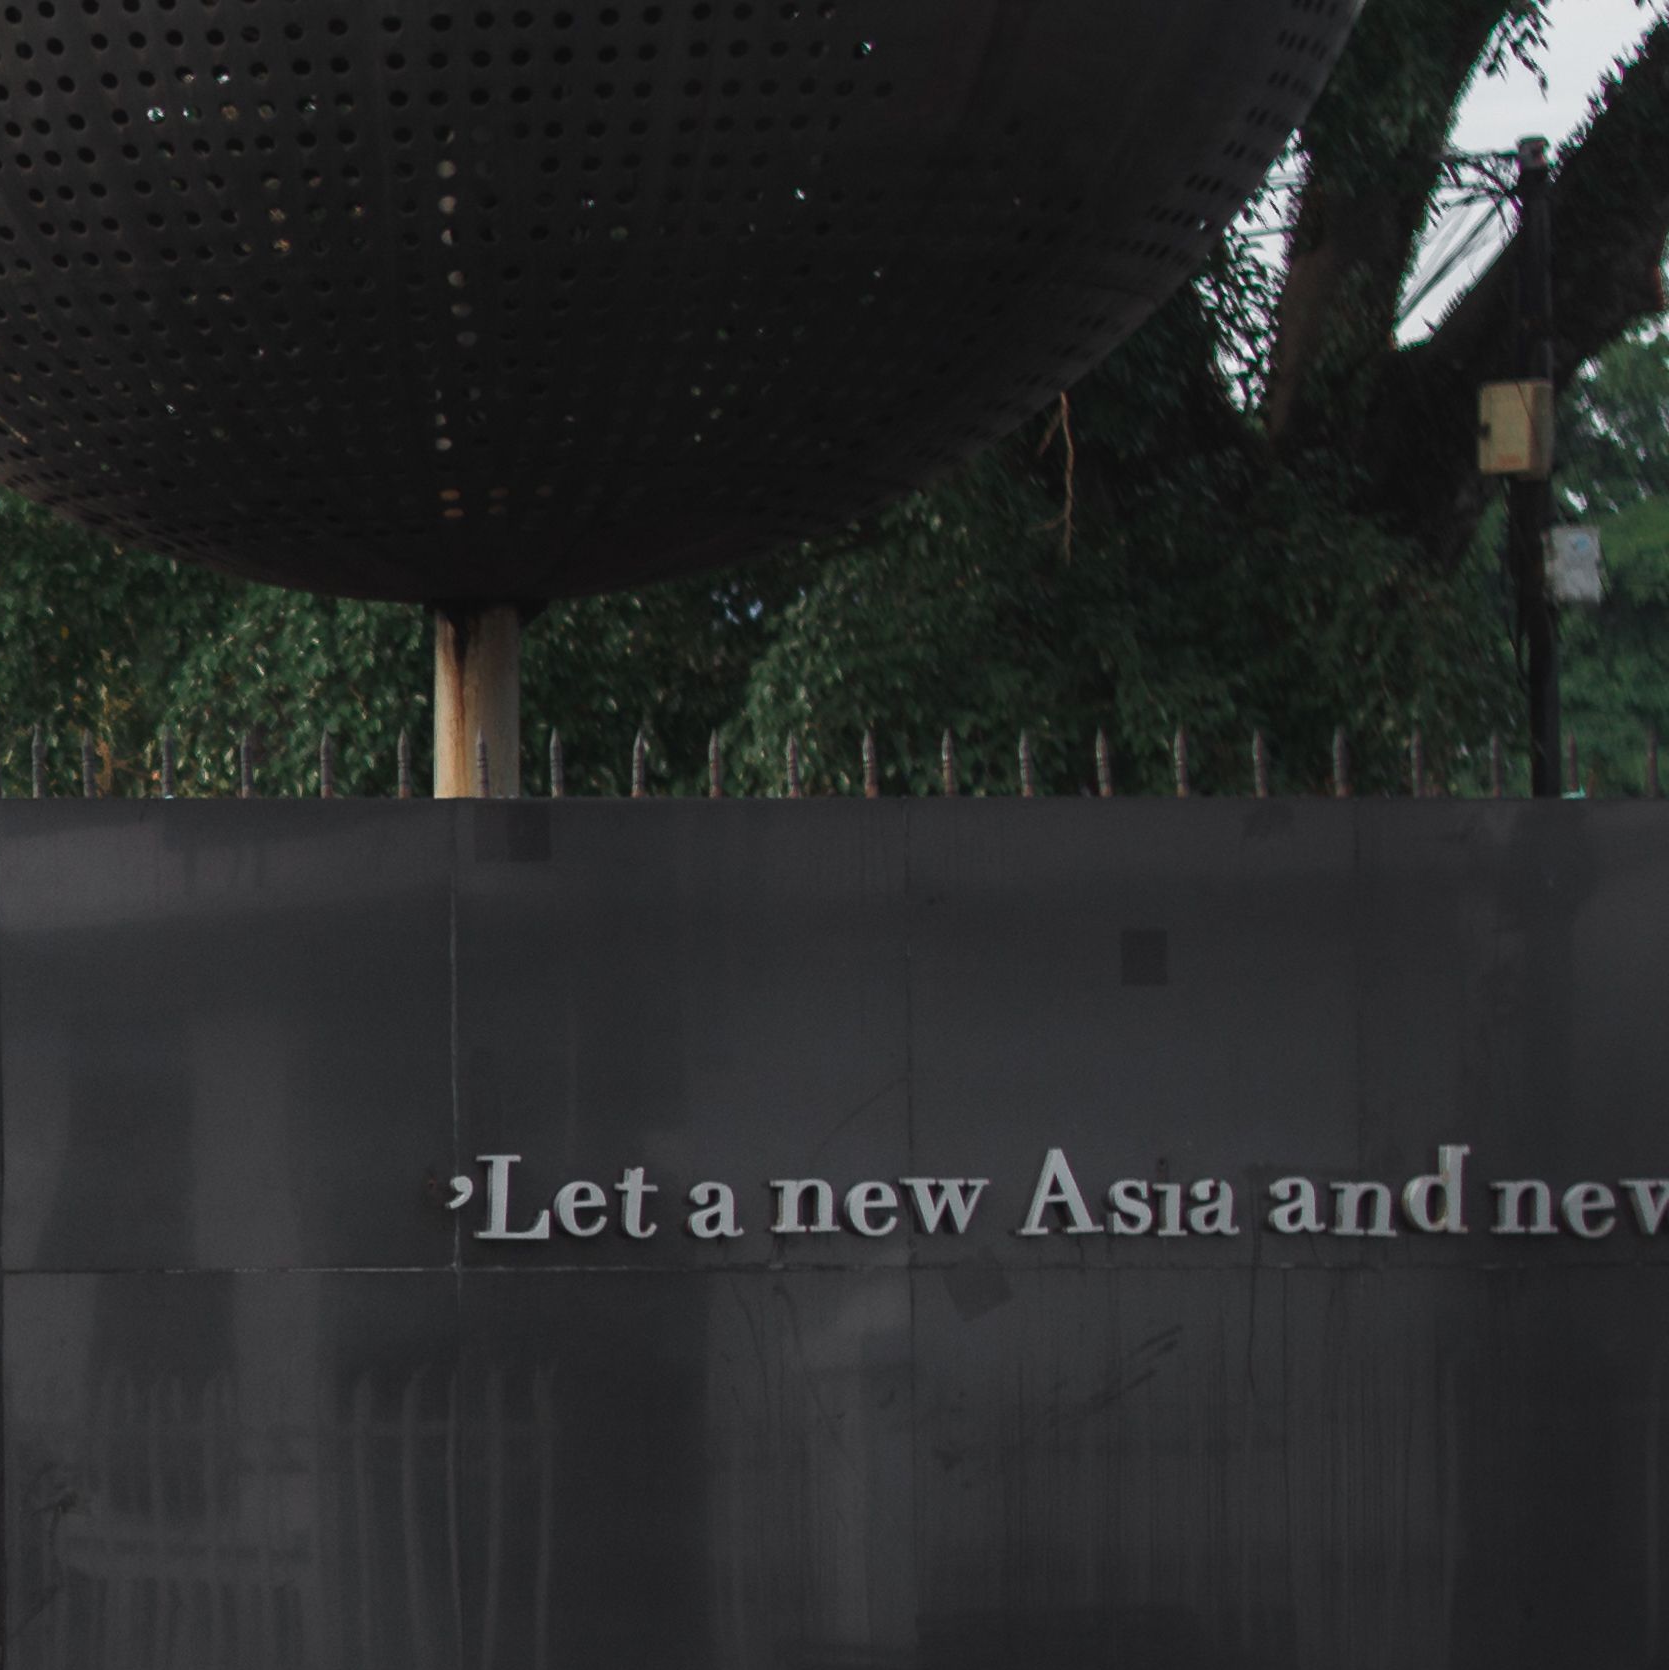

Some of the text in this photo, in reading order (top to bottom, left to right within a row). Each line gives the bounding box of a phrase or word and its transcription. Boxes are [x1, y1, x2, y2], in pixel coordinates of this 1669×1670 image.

[686, 1180, 744, 1238] a
[770, 1177, 989, 1237] new
[1017, 1147, 1240, 1237] Asia
[1269, 1144, 1470, 1237] and
